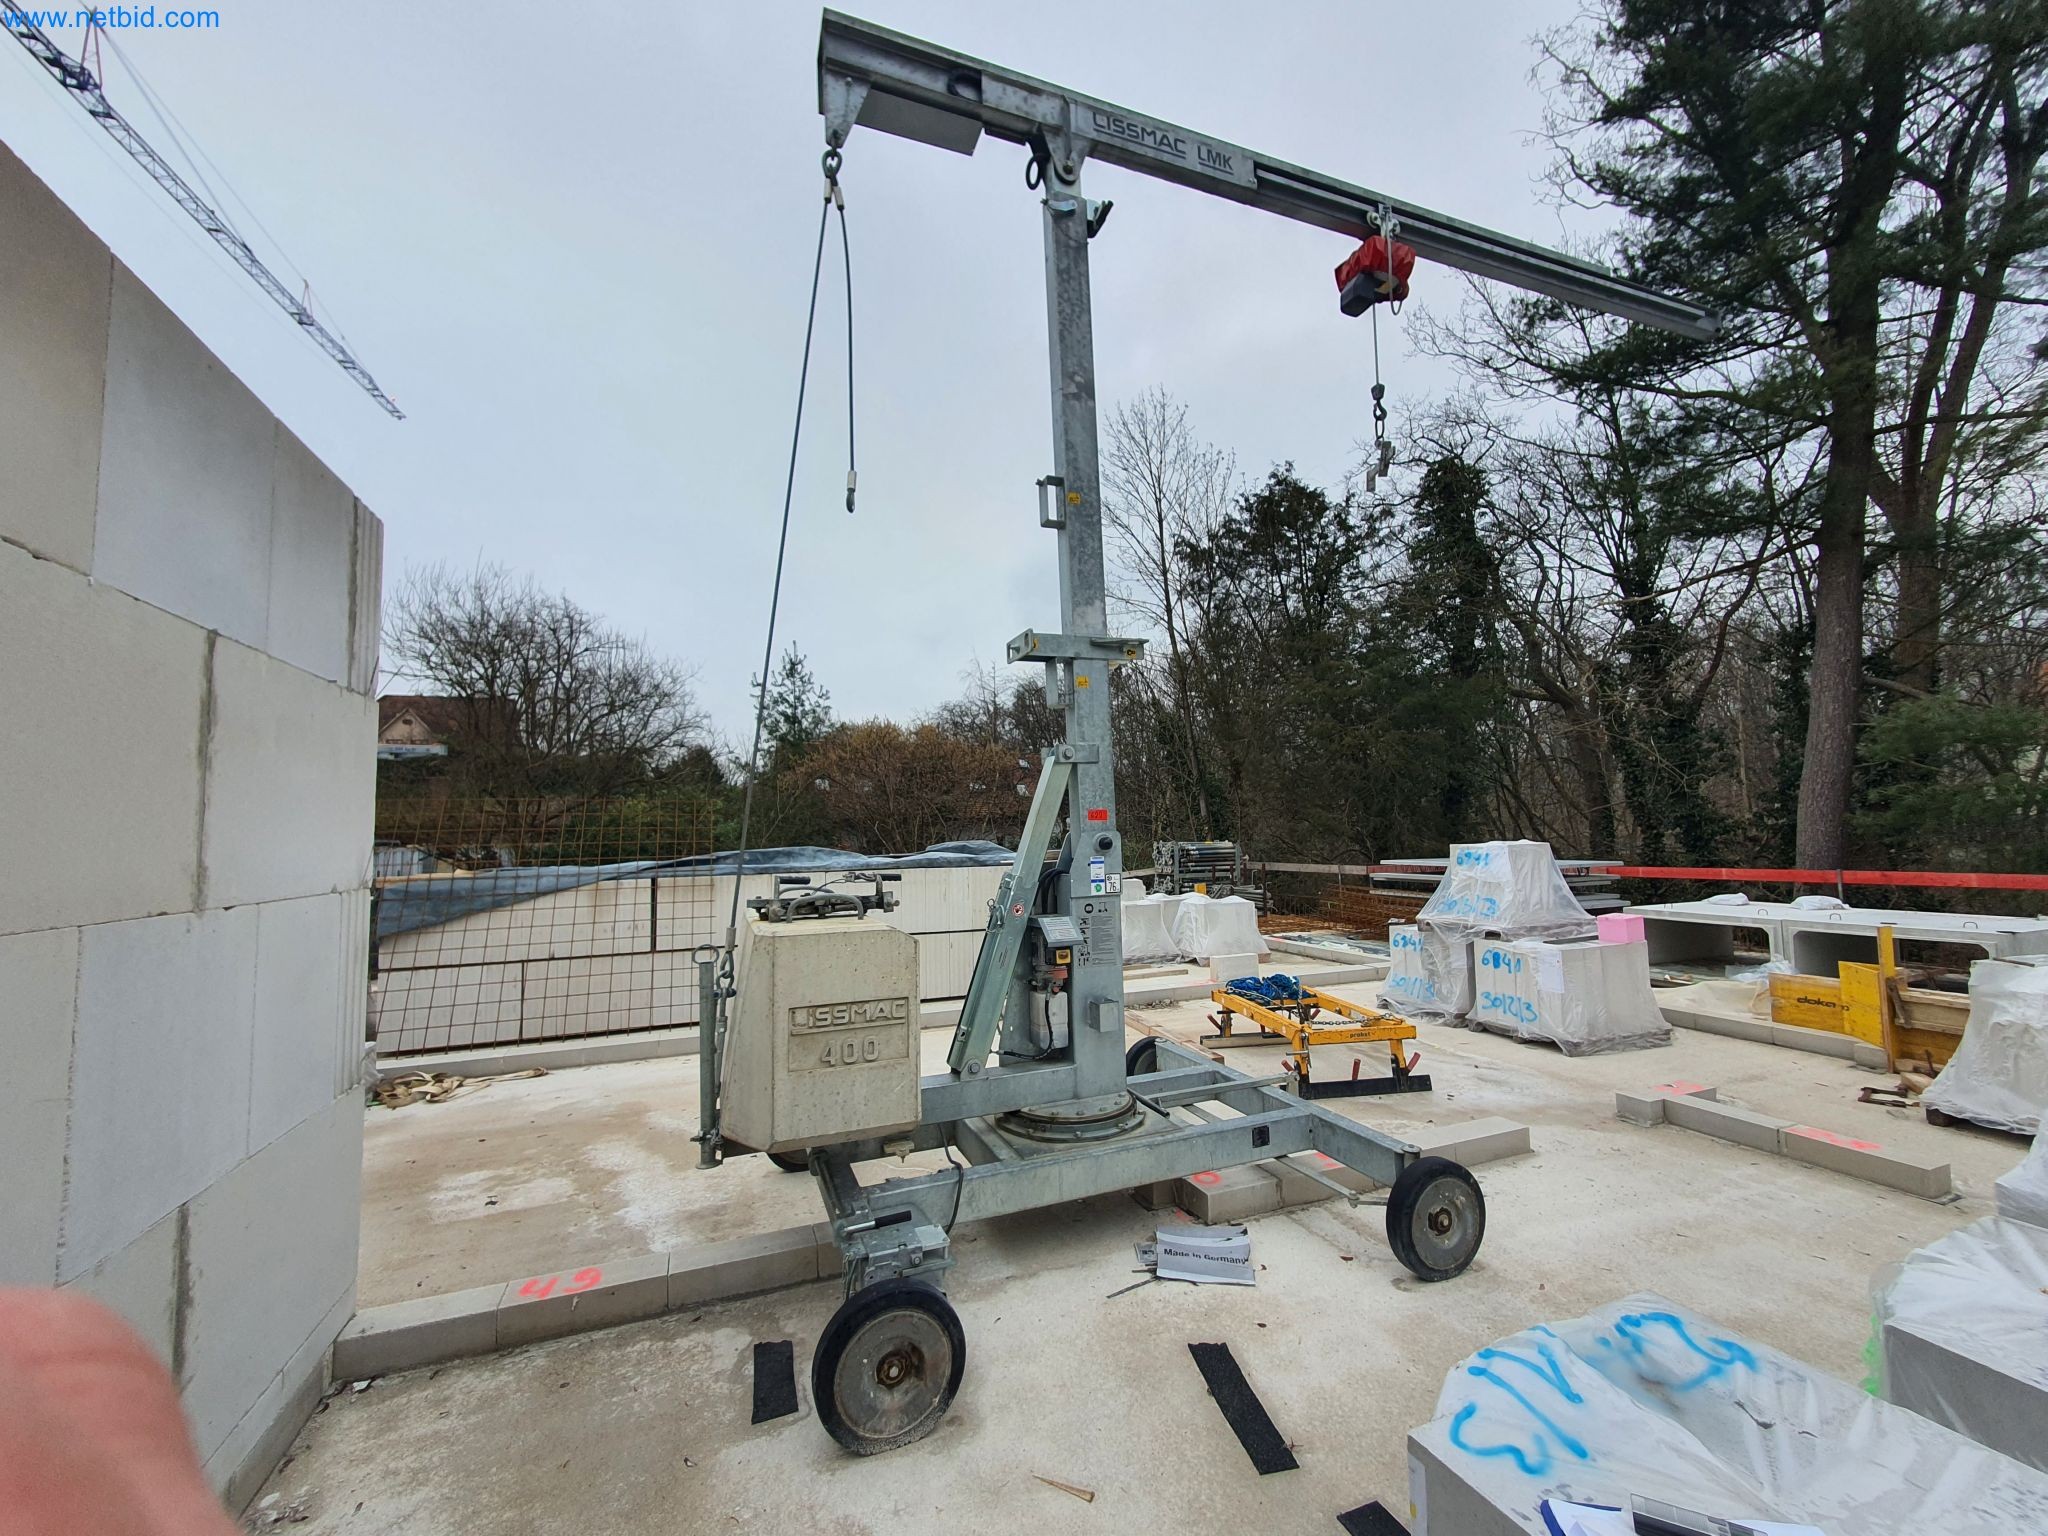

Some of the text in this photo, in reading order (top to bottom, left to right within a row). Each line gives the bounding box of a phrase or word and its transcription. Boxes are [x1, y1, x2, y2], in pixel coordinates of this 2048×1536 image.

[1092, 111, 1233, 171] LISSMAC LMK
[821, 1036, 879, 1066] 400
[1163, 1248, 1190, 1257] Made
[1203, 1254, 1249, 1265] Germany
